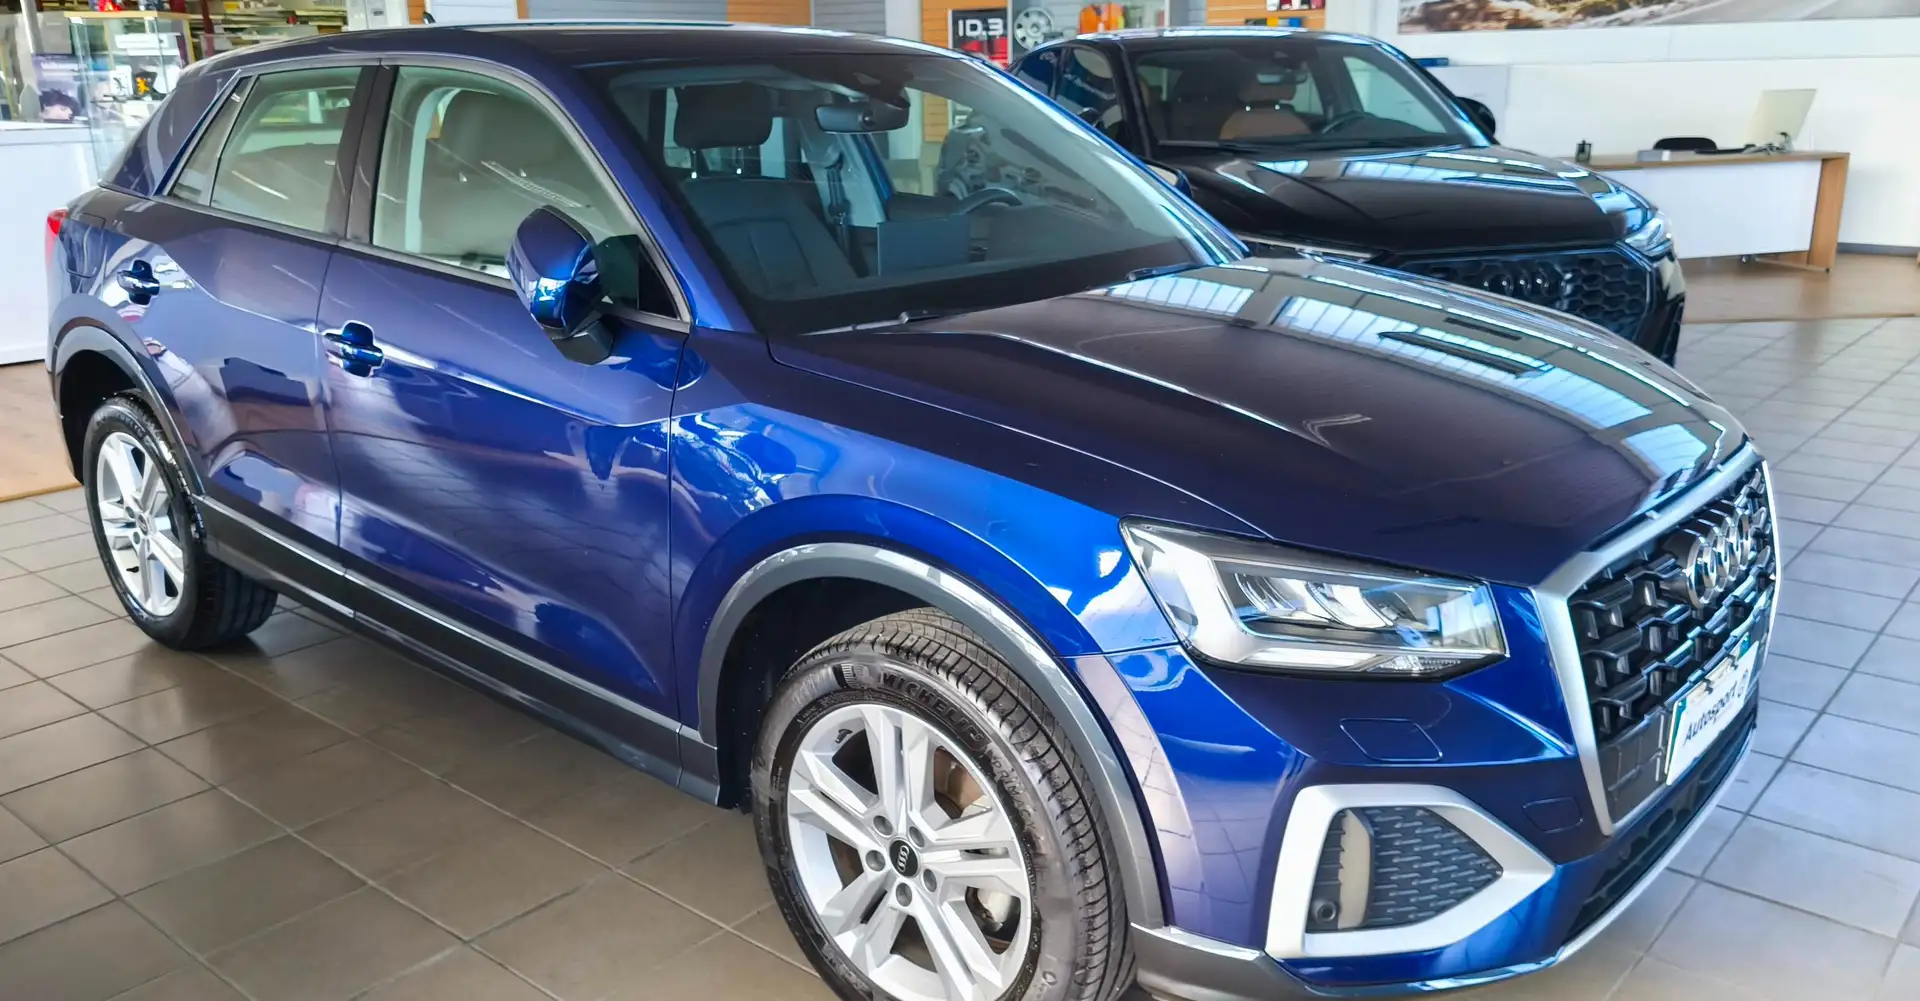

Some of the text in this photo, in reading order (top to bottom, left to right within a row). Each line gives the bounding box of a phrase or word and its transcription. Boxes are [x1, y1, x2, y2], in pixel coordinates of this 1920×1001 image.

[957, 17, 1005, 37] ID.3
[1683, 684, 1736, 746] Autosport
[990, 758, 1036, 831] PRIMACY
